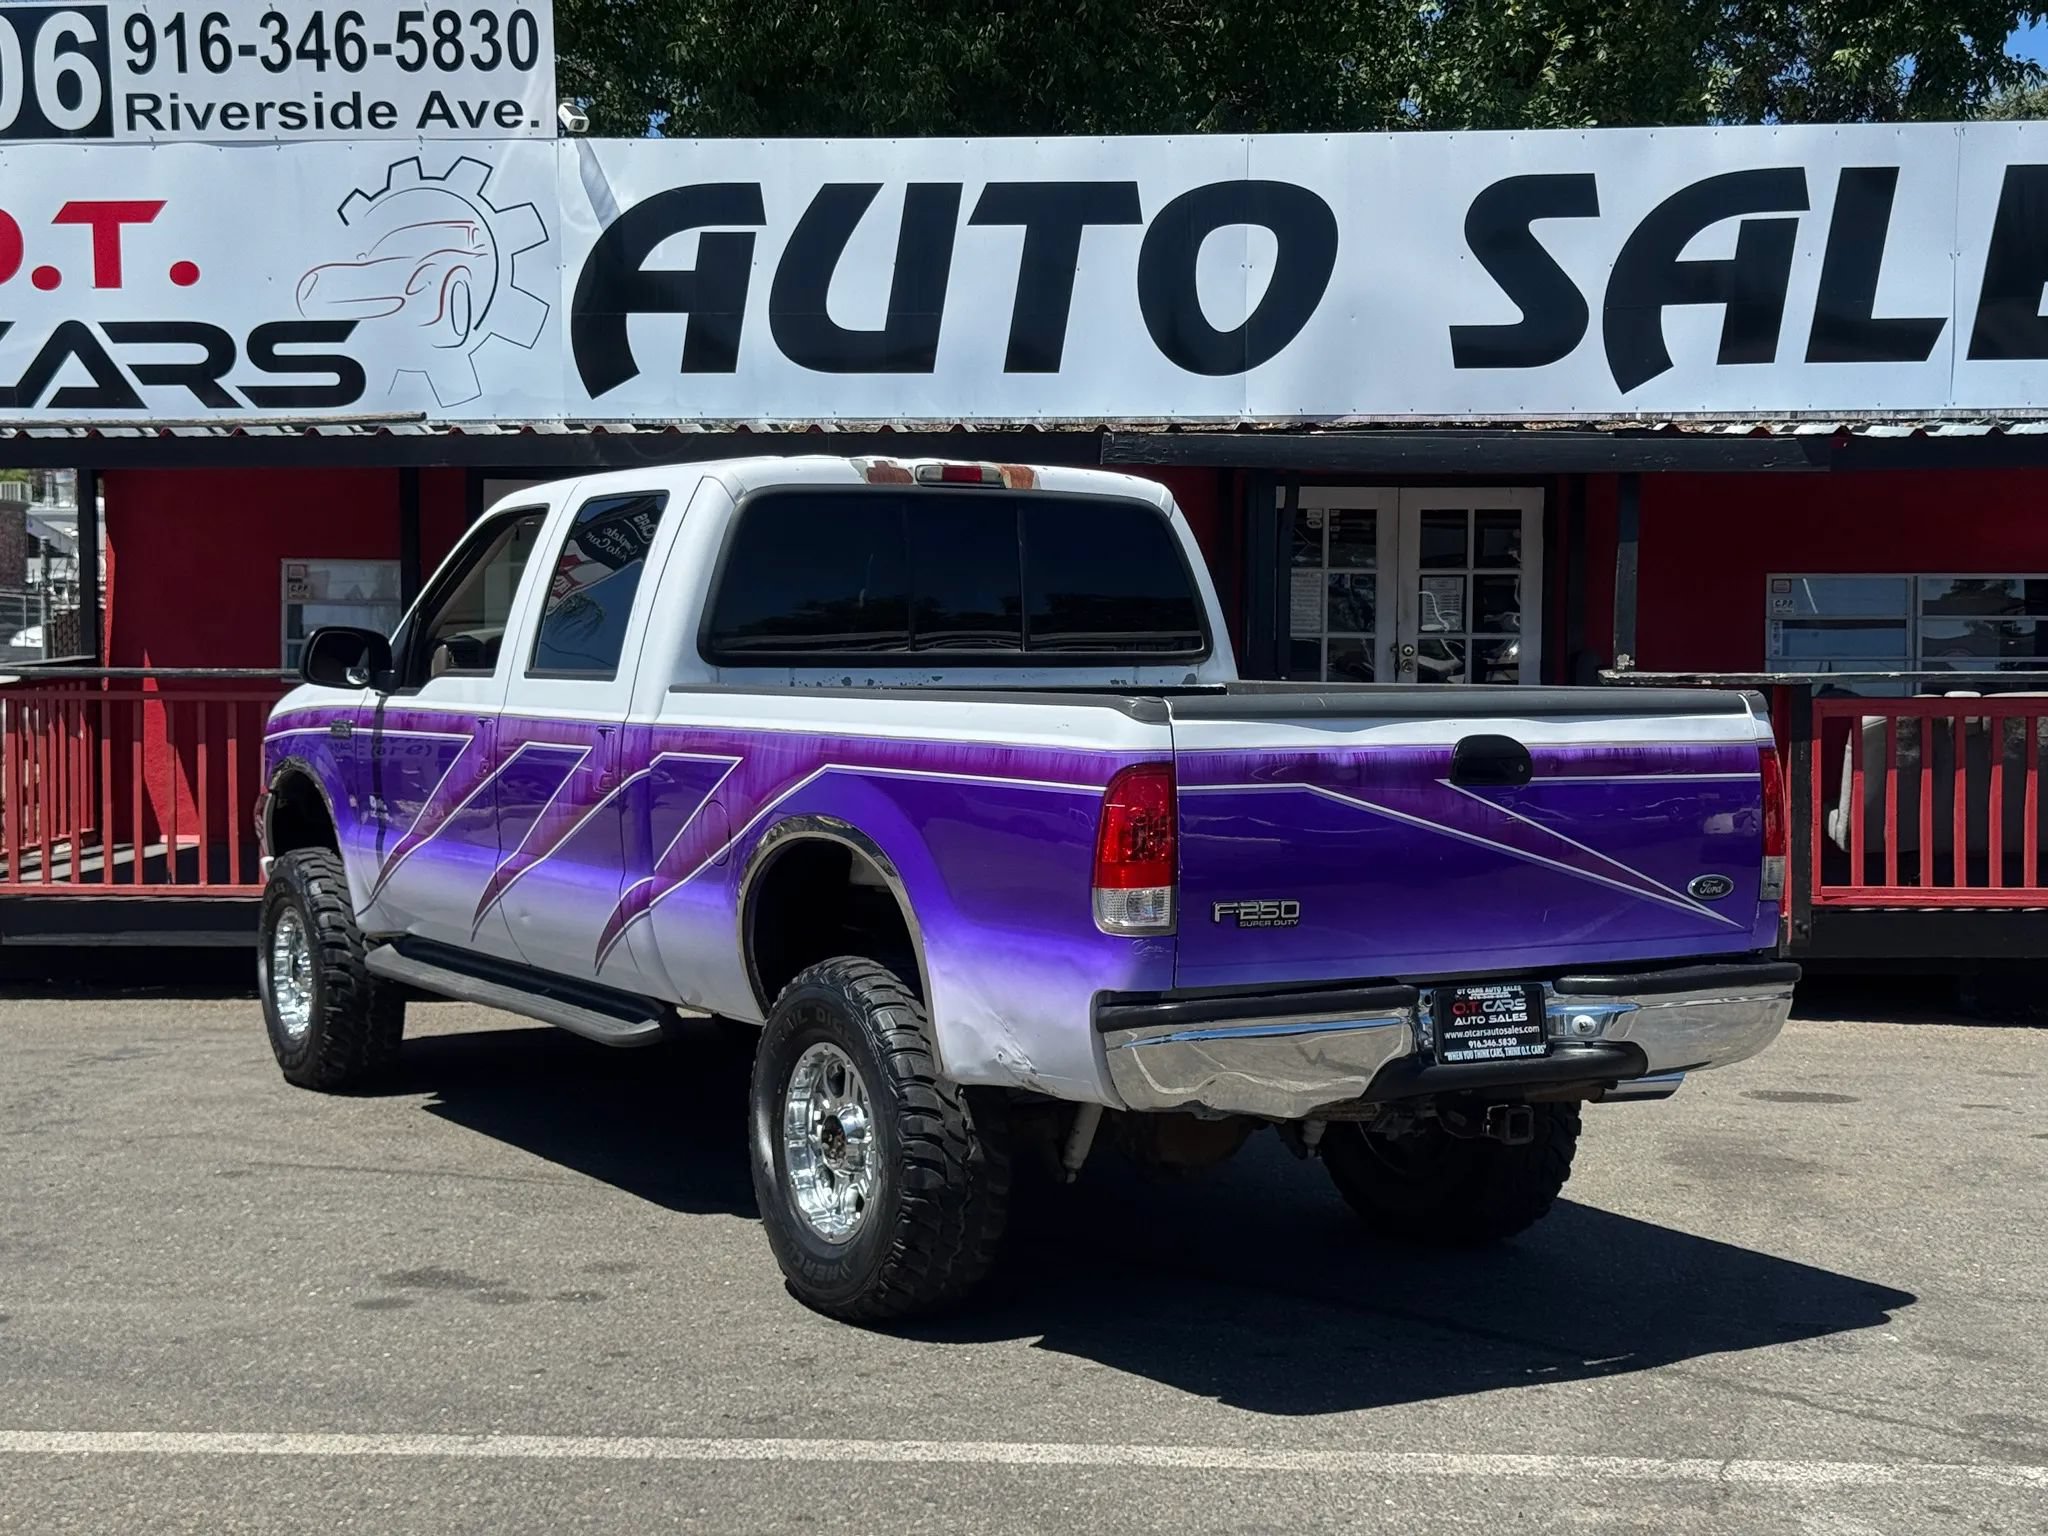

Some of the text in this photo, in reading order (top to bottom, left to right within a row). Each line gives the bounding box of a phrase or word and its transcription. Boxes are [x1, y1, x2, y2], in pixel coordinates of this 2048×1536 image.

[124, 9, 540, 76] 916-346-5830
[126, 90, 542, 132] Riverside Ave.
[571, 178, 1339, 401] AUTO
[0, 320, 367, 409] ARS
[1699, 878, 1724, 894] Ford
[1483, 998, 1527, 1013] CARS
[1454, 1013, 1528, 1026] AUTO SALES
[1444, 1025, 1540, 1039] www.otcarsautosales.com
[1468, 1038, 1517, 1048] 916.346.5830
